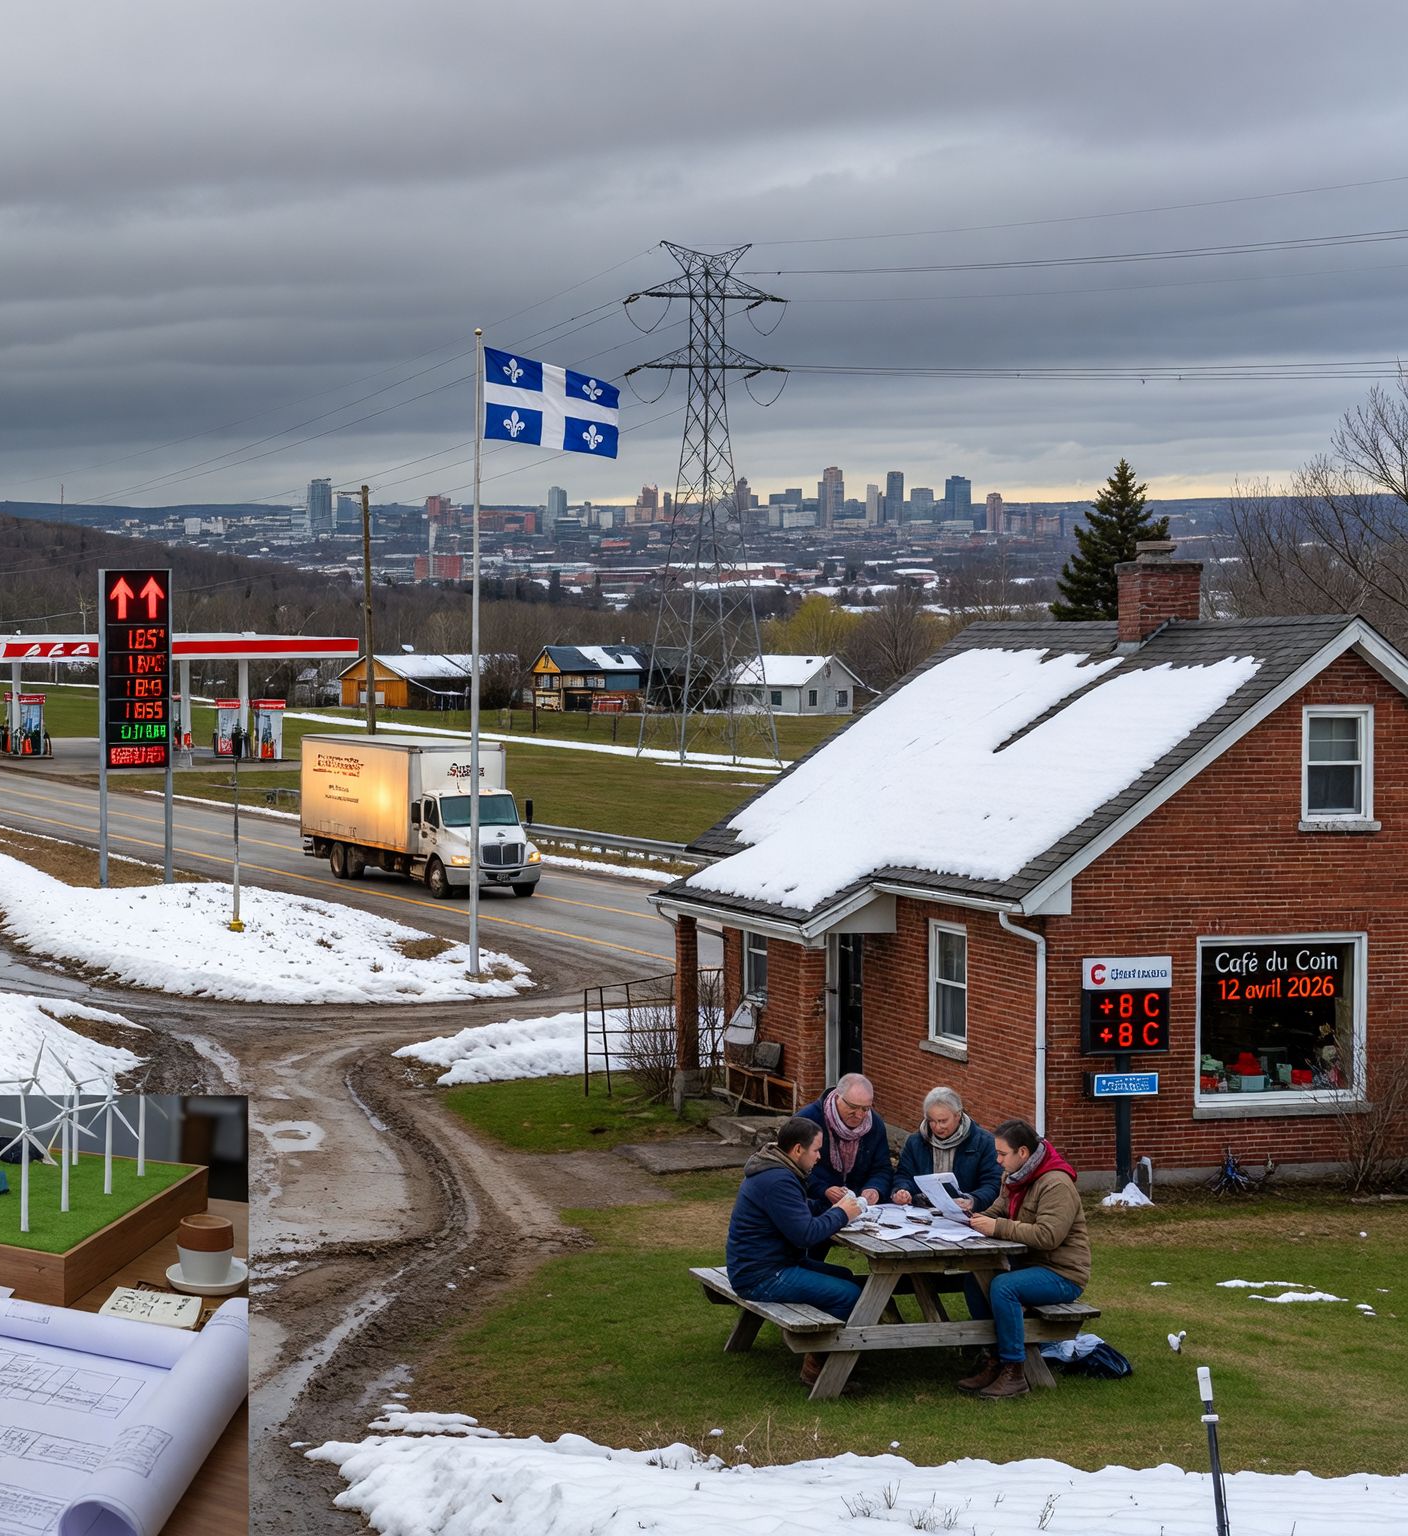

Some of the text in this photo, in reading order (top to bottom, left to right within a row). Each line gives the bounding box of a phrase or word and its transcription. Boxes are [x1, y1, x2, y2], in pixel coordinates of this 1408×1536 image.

[1215, 950, 1338, 976] Café du Coin
[1217, 976, 1335, 1000] 12 avril 2026
[1144, 993, 1160, 1017] C
[1143, 1022, 1159, 1046] C
